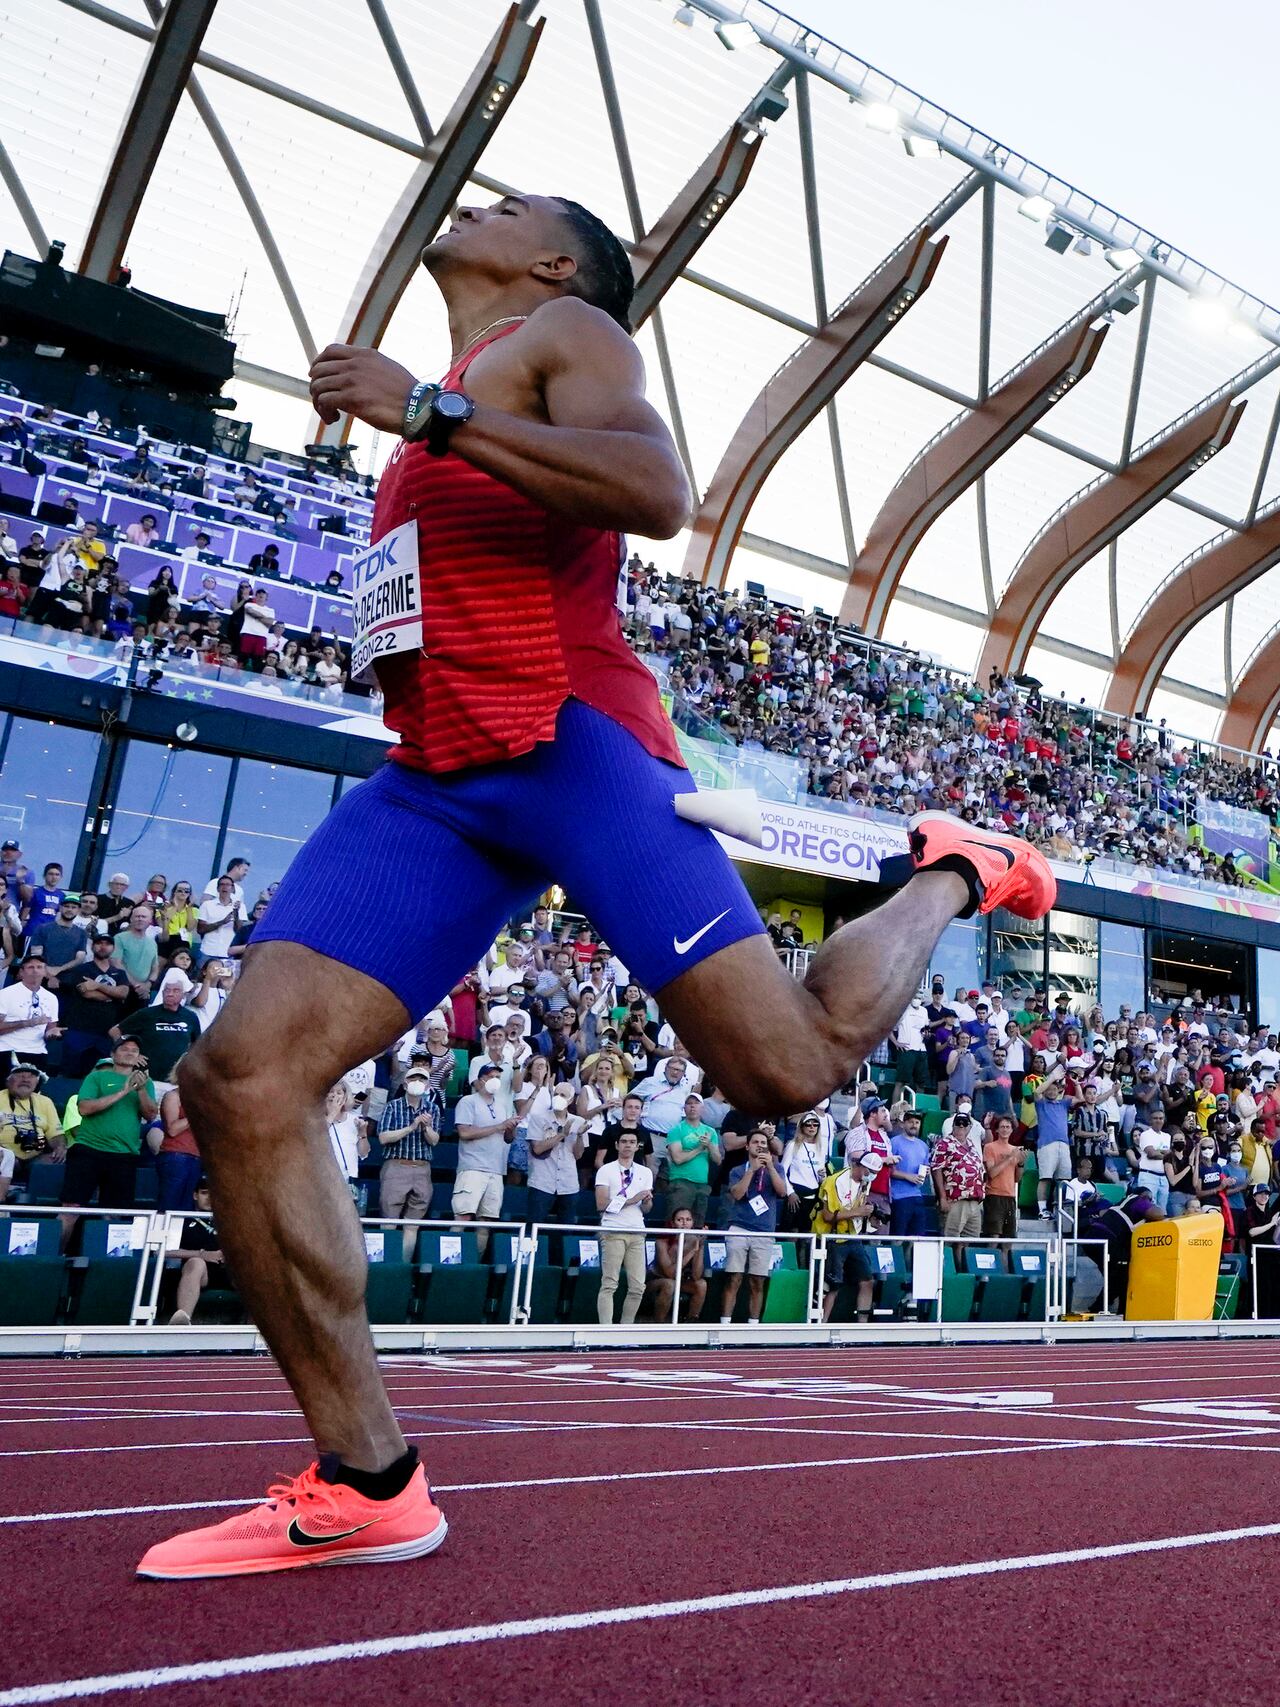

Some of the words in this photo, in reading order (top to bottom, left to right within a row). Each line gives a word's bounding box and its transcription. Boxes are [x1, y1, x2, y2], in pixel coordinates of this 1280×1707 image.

[354, 537, 399, 588] TDK
[761, 811, 795, 827] WORLD
[797, 820, 850, 839] ATHLETICS
[762, 825, 904, 870] OREGON
[1137, 1234, 1173, 1248] SEIKO
[1187, 1238, 1214, 1247] SEIKO
